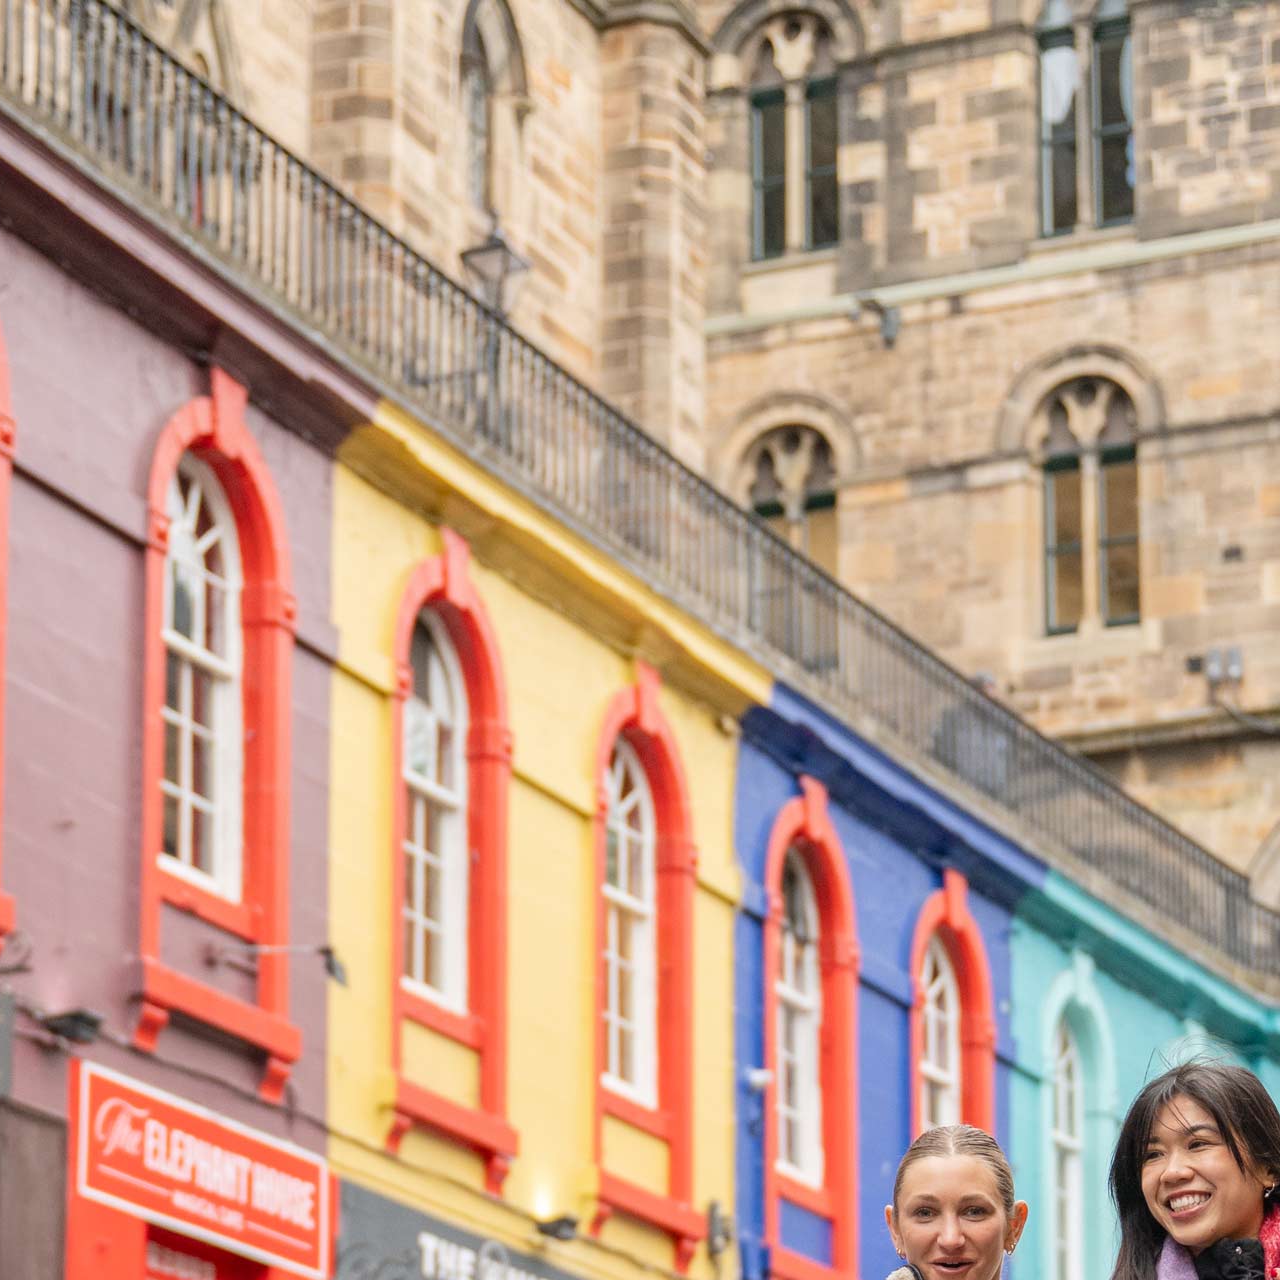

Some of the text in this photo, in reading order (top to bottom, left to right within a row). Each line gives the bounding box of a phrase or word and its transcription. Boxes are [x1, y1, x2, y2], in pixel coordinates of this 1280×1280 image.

[94, 1096, 316, 1231] The ELEPHANT HOUSE
